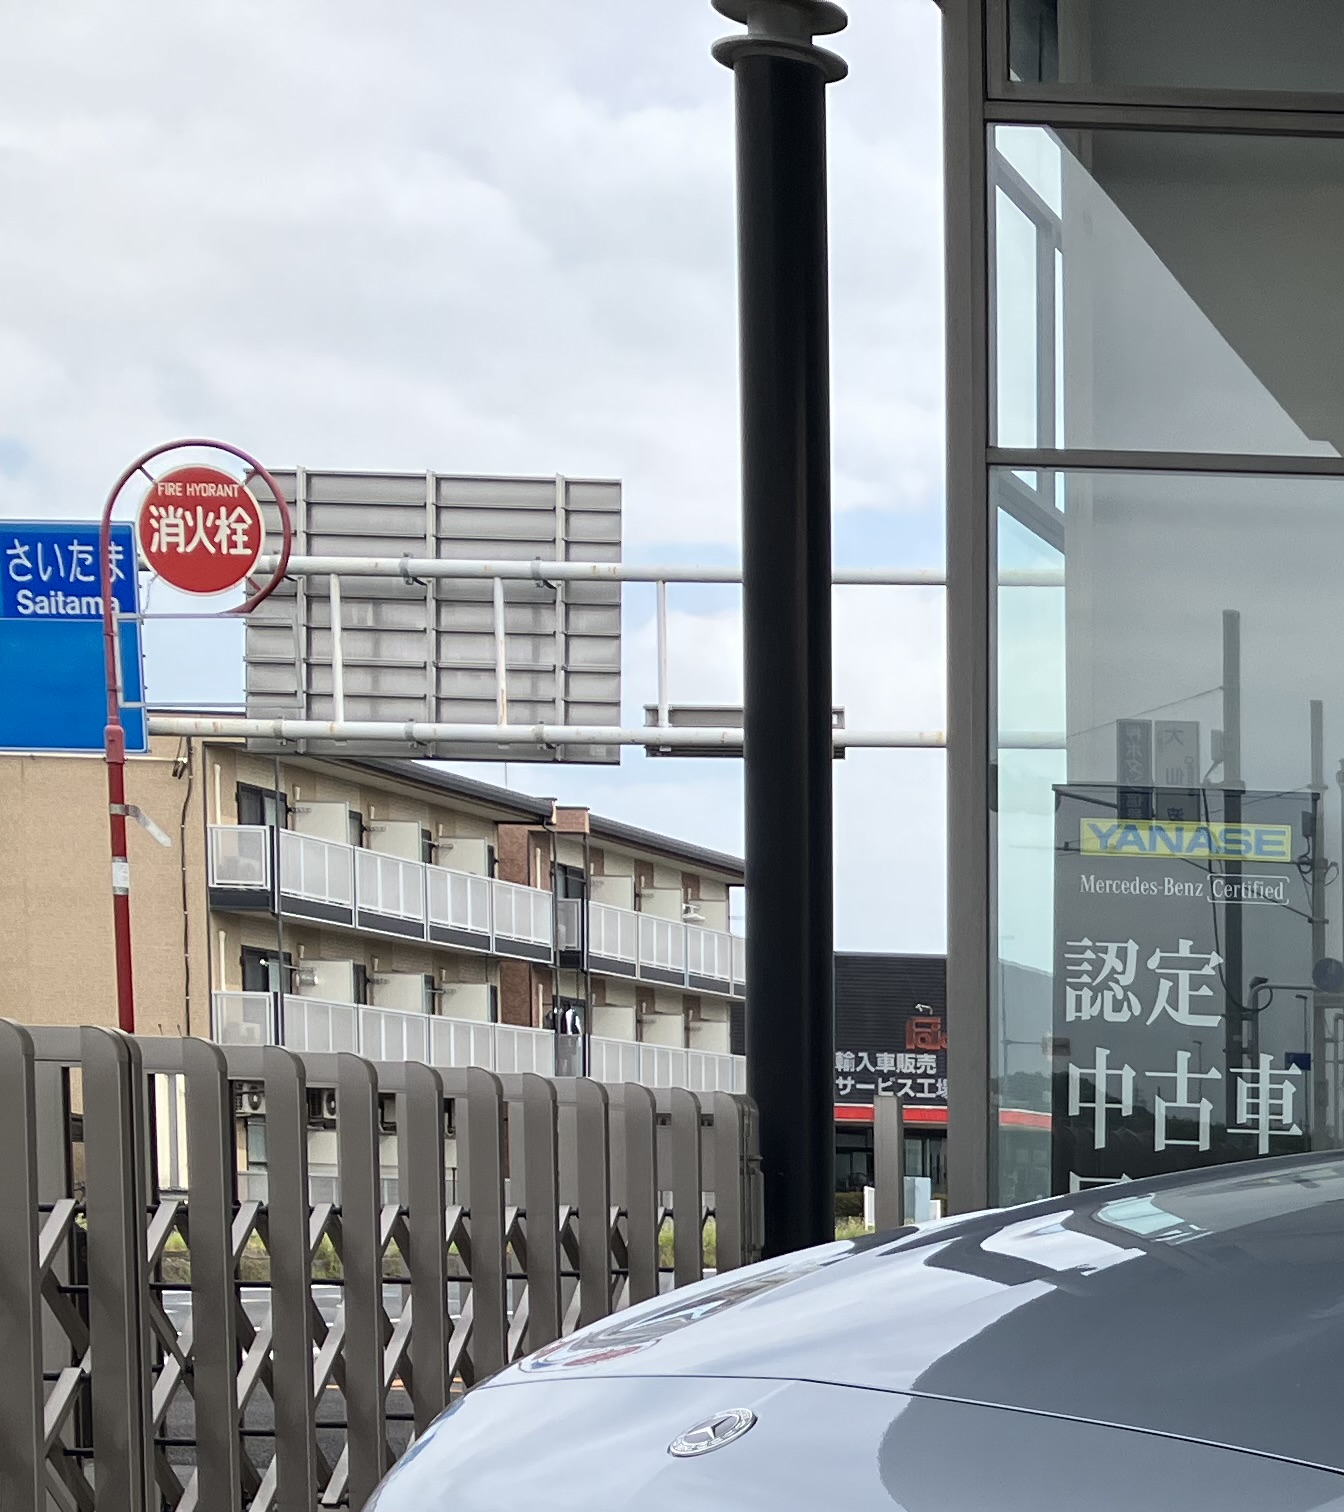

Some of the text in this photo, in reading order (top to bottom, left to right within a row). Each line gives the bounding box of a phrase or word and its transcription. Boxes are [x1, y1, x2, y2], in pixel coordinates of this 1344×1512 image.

[157, 482, 239, 498] FIRE HYDRANT
[148, 504, 253, 555] 消火栓
[5, 538, 126, 583] さいたま
[1087, 822, 1287, 857] YANASE
[1079, 874, 1285, 900] Mercedes-Benz Certified
[1063, 936, 1224, 1028] 認定
[835, 1051, 938, 1074] 輸入車販売
[1067, 1046, 1303, 1155] 中古車
